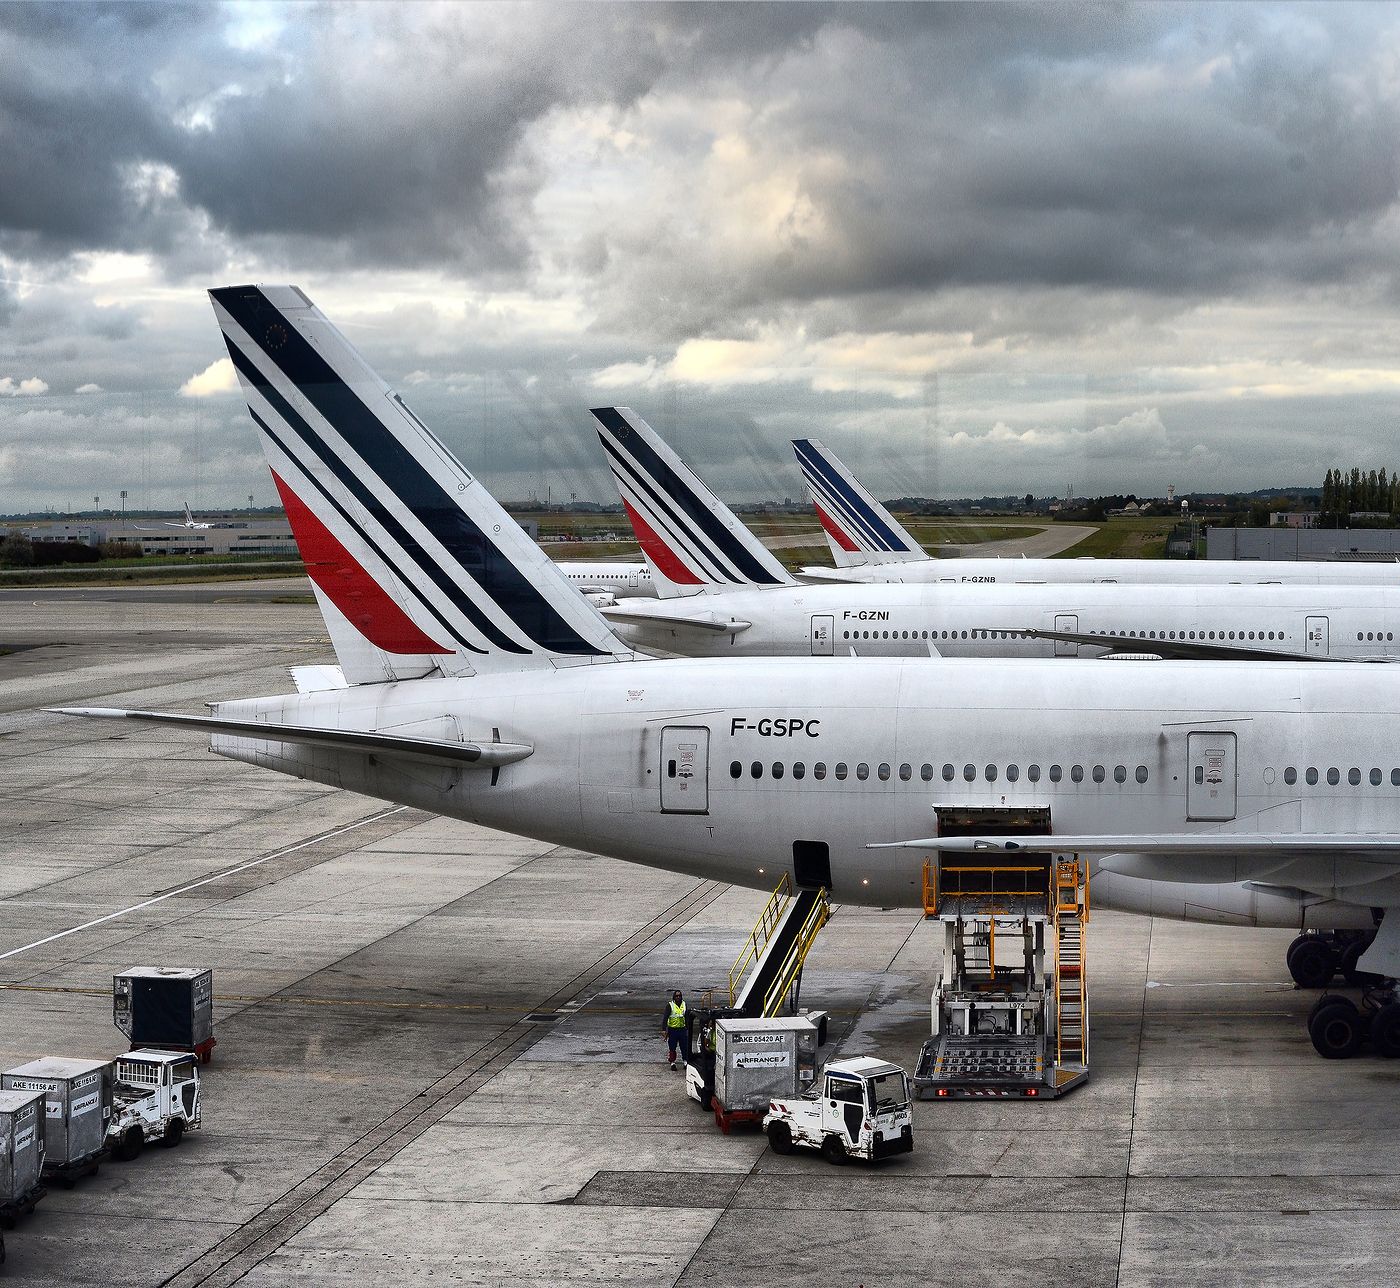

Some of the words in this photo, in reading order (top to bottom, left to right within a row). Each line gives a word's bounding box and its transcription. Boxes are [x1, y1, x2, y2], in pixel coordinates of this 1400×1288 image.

[843, 611, 889, 621] F-GZNI
[730, 717, 821, 738] F-GSPC
[12, 1081, 26, 1089] AKE
